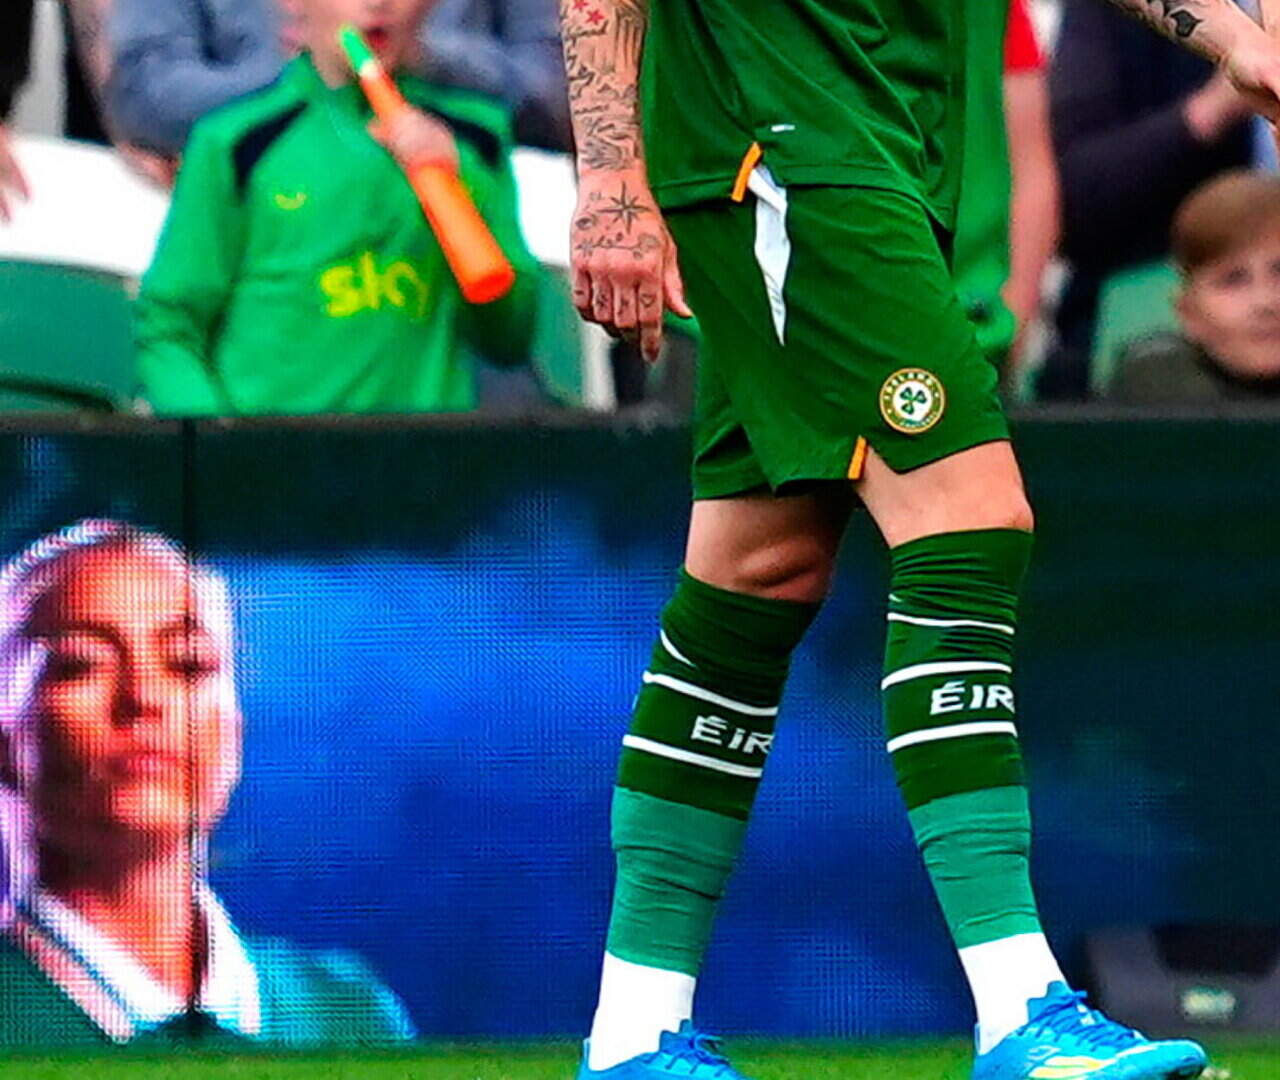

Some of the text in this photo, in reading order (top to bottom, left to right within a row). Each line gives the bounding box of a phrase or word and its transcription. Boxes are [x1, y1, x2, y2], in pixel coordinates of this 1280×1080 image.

[319, 251, 430, 319] sky
[930, 680, 1016, 716] ÉIR
[690, 715, 776, 755] ÉIR
